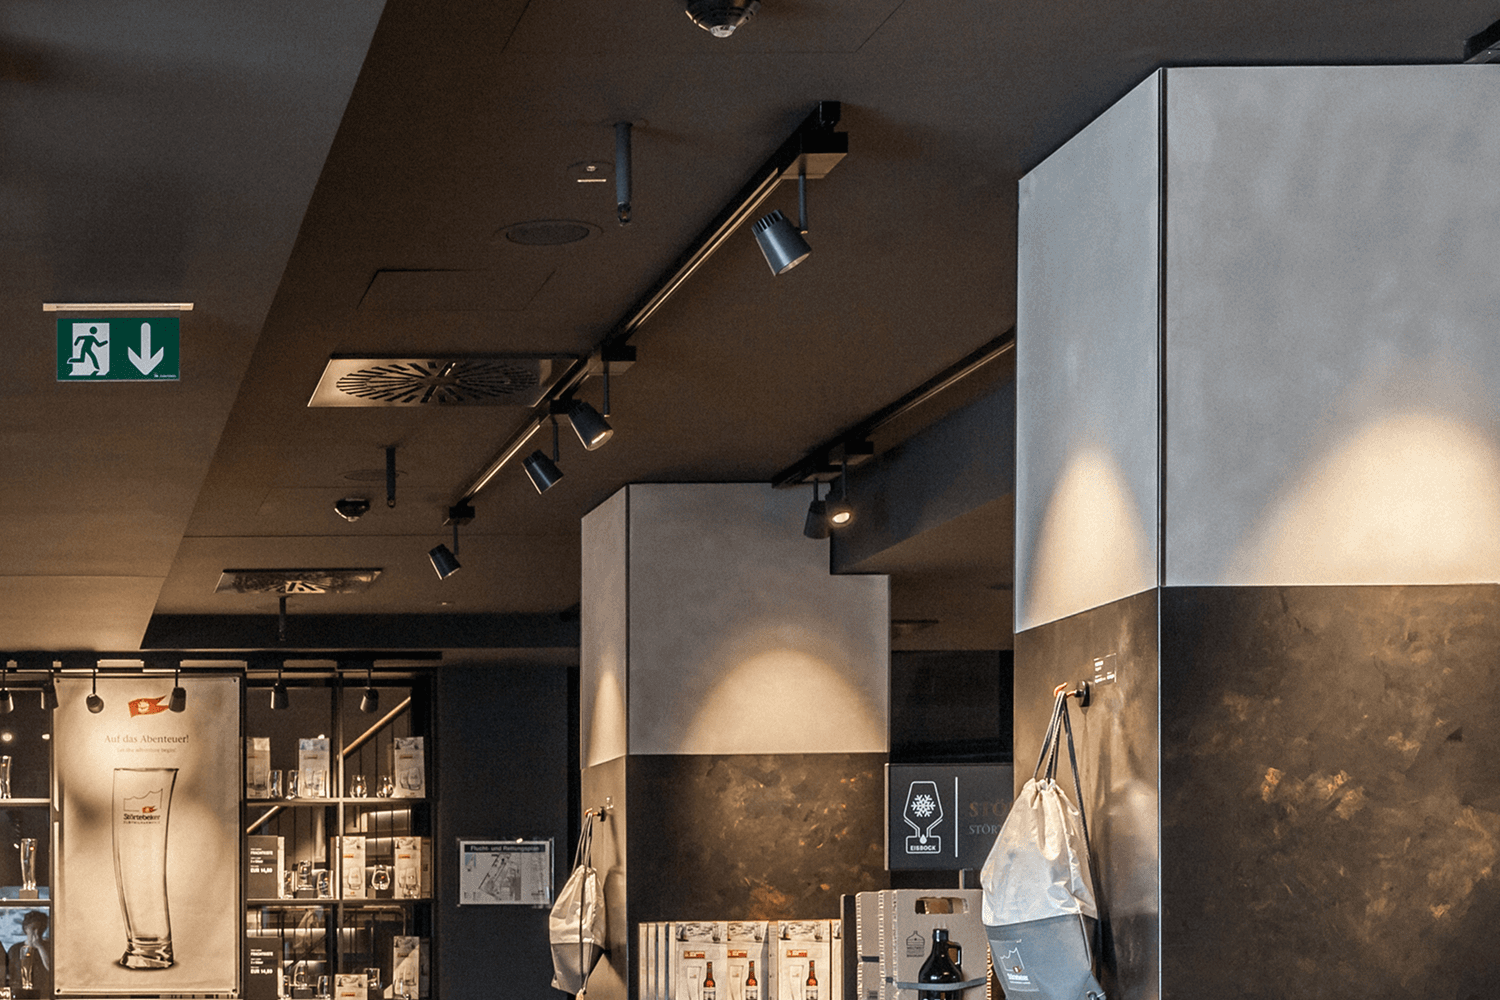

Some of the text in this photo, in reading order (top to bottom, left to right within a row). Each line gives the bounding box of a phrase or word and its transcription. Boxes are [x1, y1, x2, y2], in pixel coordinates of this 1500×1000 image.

[104, 734, 189, 743] Auf das Abenteuer!
